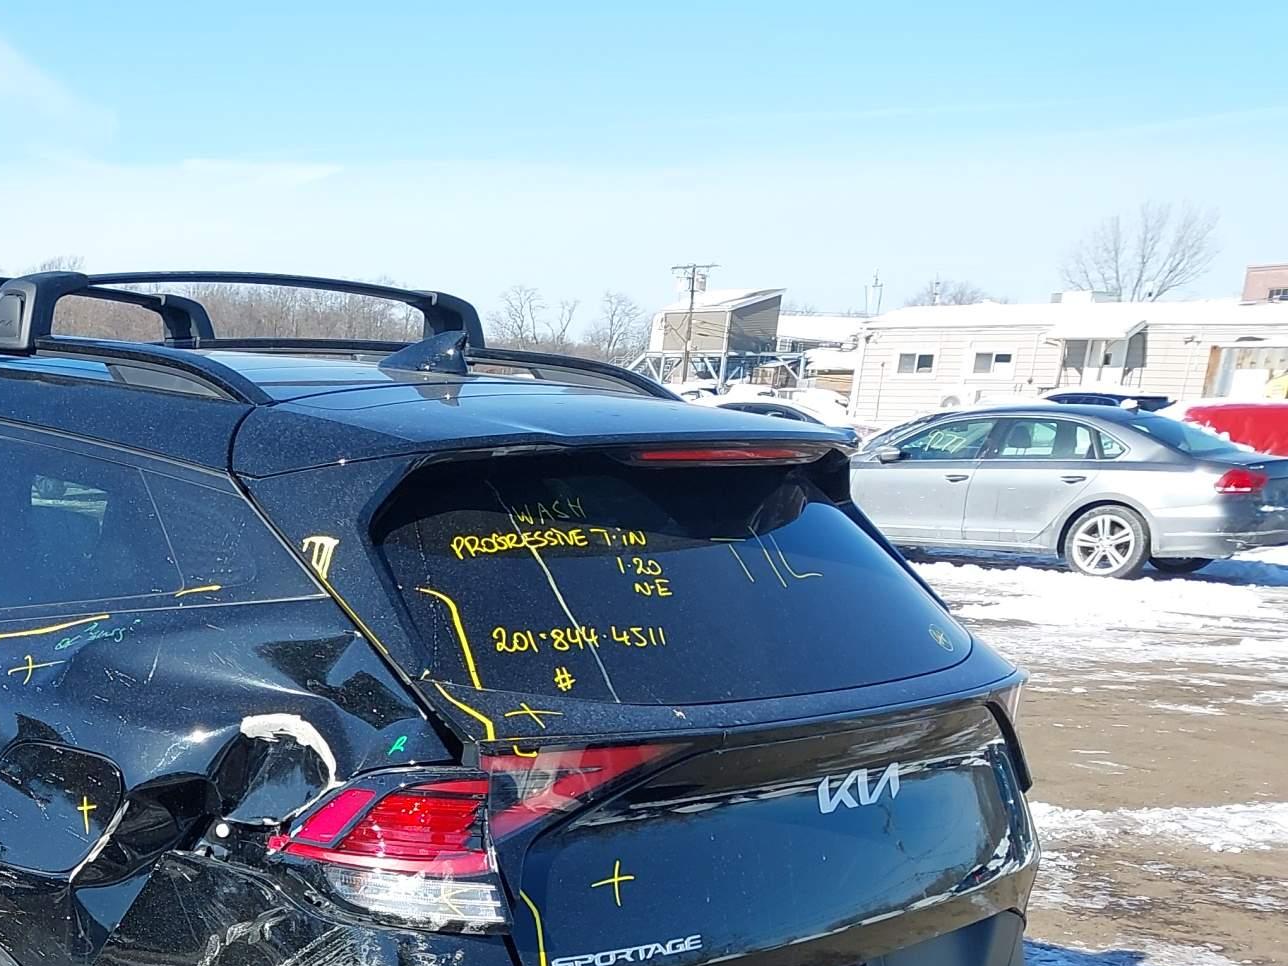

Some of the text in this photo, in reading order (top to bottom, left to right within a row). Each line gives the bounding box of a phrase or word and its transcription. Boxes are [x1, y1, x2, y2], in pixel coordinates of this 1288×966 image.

[450, 527, 589, 560] PROGRESSIVE
[553, 665, 577, 692] #
[817, 761, 901, 815] KIA
